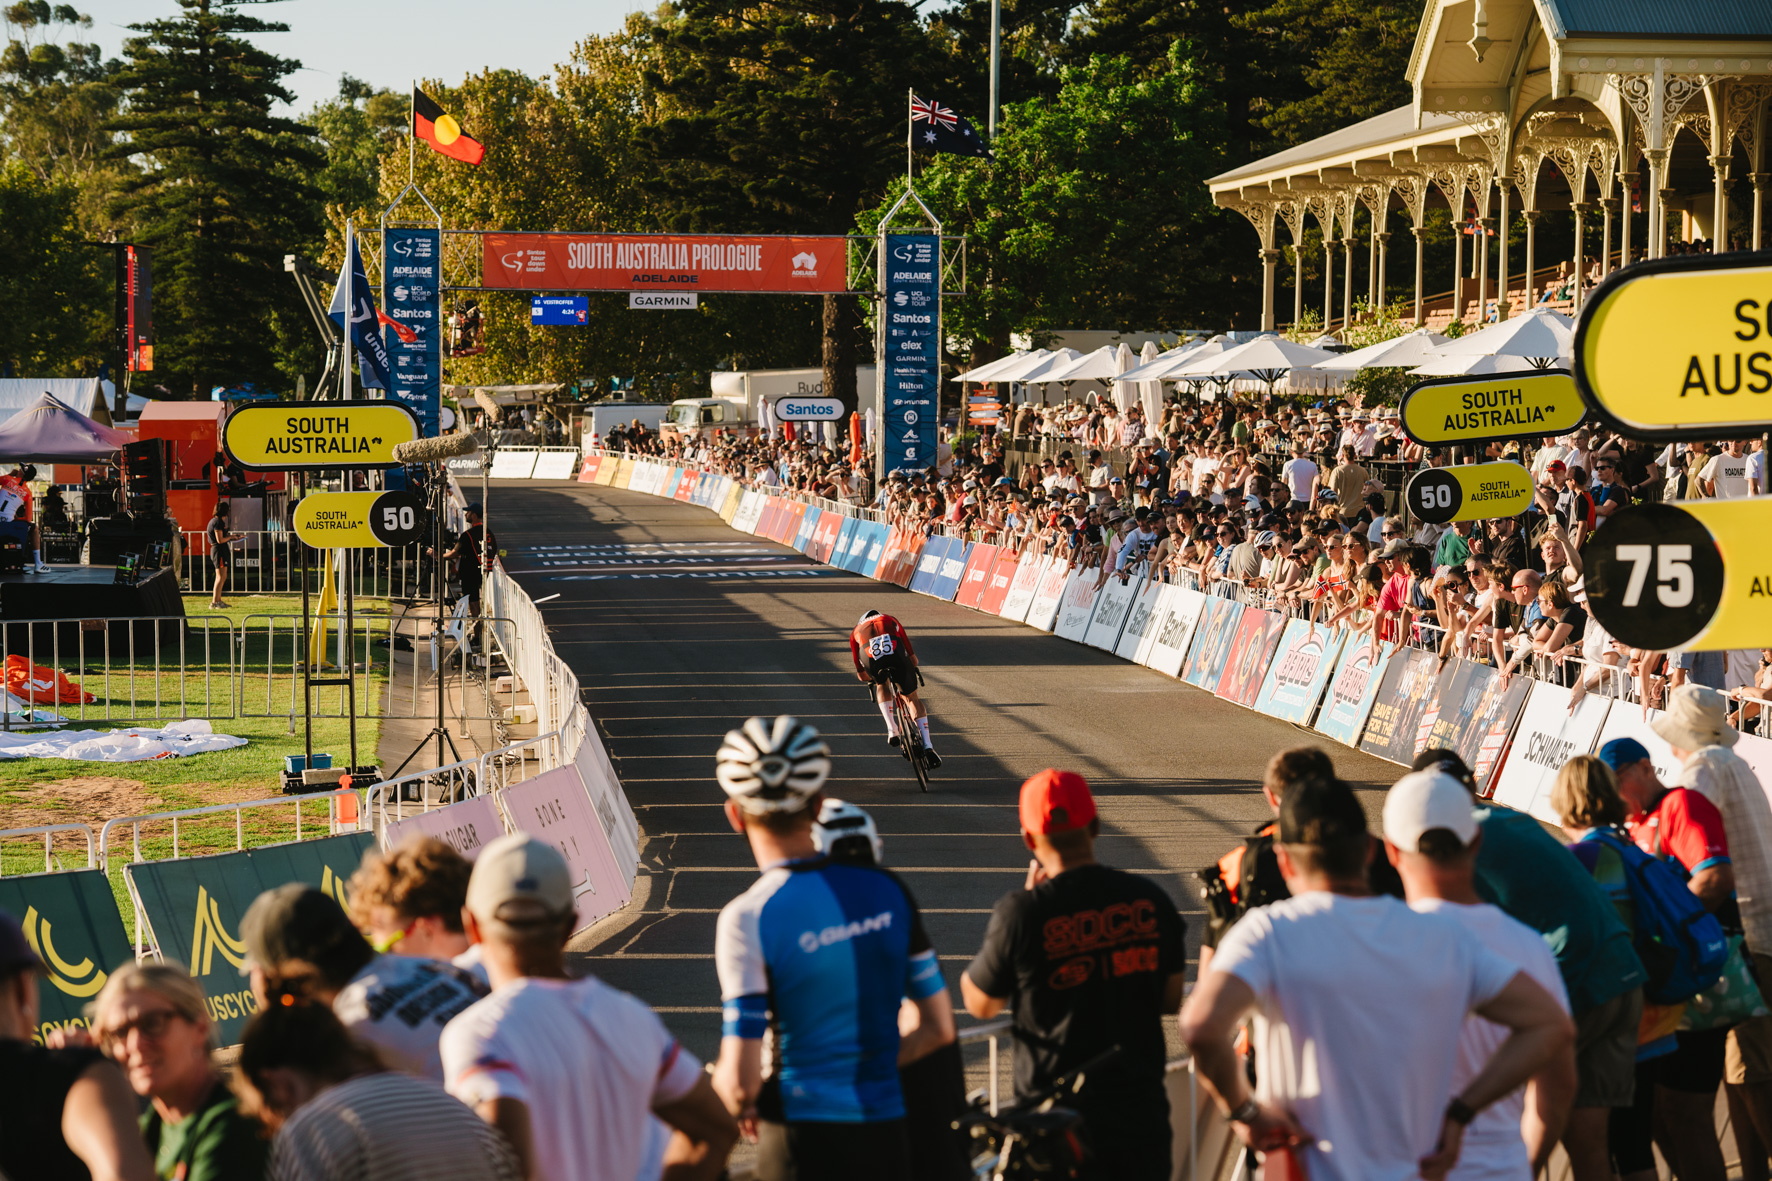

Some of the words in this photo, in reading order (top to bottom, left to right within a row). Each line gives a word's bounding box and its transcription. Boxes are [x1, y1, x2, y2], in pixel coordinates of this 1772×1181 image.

[568, 242, 612, 269] SOUTH
[616, 243, 689, 270] AUSTRALIA
[692, 244, 762, 271] PROLOGUE
[393, 266, 432, 274] ADELAIDE
[632, 274, 698, 283] ADELAIDE
[634, 296, 690, 306] GARMIN
[393, 308, 432, 318] Santos
[893, 313, 931, 323] Santos
[1734, 299, 1772, 341] S
[900, 341, 922, 350] efex
[396, 373, 428, 381] Vanguard
[1462, 388, 1522, 410] SOUTH
[786, 403, 834, 415] Santos
[286, 417, 349, 434] SOUTH
[1443, 406, 1545, 432] AUSTRALIA
[265, 436, 370, 454] AUSTRALIA
[1480, 481, 1510, 492] SOUTH
[1420, 484, 1452, 509] 50
[1470, 490, 1521, 502] AUSTRALIA
[316, 511, 347, 520] SOUTH
[383, 506, 415, 531] 50
[305, 521, 358, 530] AUSTRALIA
[543, 558, 714, 566] HYUNDAI
[630, 570, 820, 579] HYUNDAI
[1616, 544, 1694, 608] 75
[1095, 592, 1128, 628] Santini
[1128, 602, 1162, 640] Santini
[1158, 610, 1192, 650] Santini
[872, 640, 892, 656] 85
[1372, 702, 1392, 720] SAVE
[1391, 706, 1400, 721] IT
[1368, 718, 1382, 734] FOR
[1381, 721, 1395, 736] THE
[1432, 718, 1454, 737] SAVE
[1451, 726, 1462, 740] IT
[1524, 730, 1574, 770] SCHWALBE
[535, 799, 566, 828] BONE
[446, 823, 481, 854] SUGAR
[819, 911, 893, 946] GIANT
